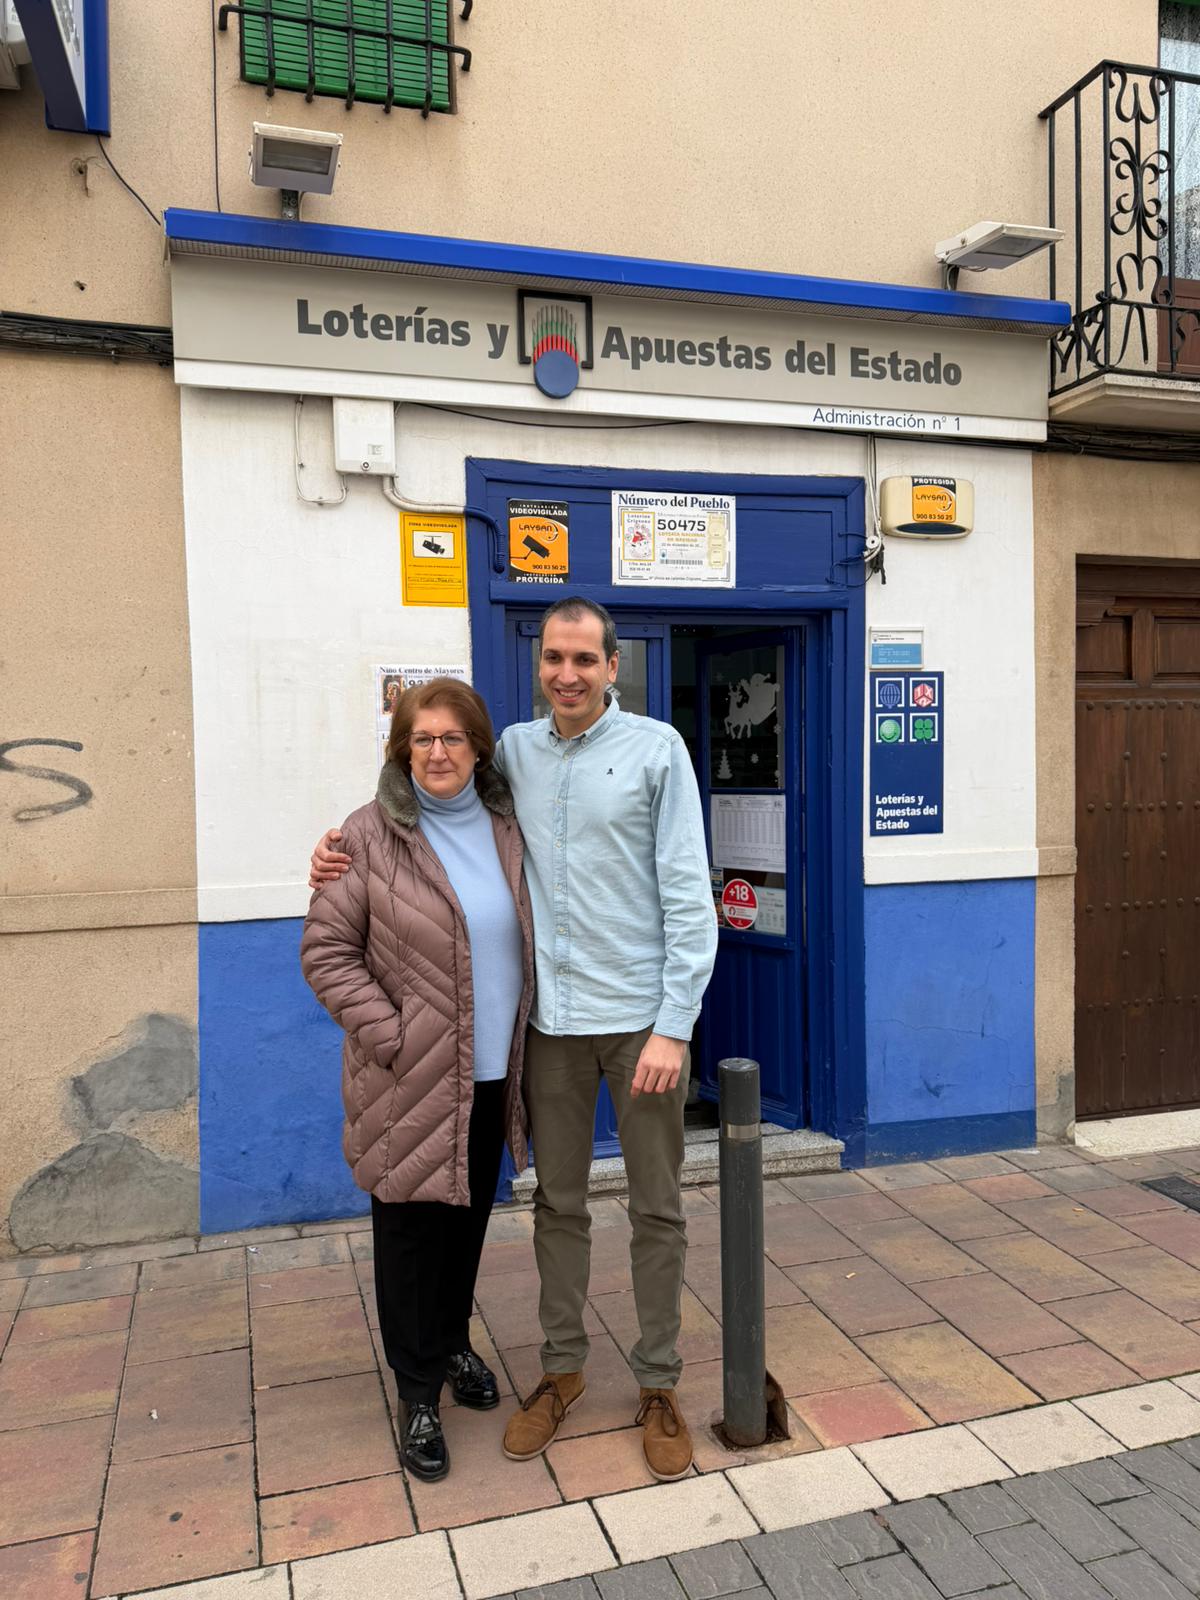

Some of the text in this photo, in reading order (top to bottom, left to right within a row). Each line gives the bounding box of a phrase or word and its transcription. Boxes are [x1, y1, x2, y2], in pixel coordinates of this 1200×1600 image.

[297, 299, 962, 386] Loterías y Apuestas del Estado
[813, 408, 926, 430] Administración
[954, 417, 961, 431] 1
[618, 494, 730, 509] Número del Pueblo
[510, 507, 568, 517] VIDEOVIGILADA
[518, 524, 553, 532] LAYSAN
[657, 519, 706, 531] 50475
[516, 576, 564, 584] PROTEGIDA
[433, 667, 465, 676] Mayores
[875, 793, 924, 806] Loterías y
[876, 805, 938, 819] Apuestas del
[875, 819, 910, 830] Estado
[729, 884, 749, 901] +18
